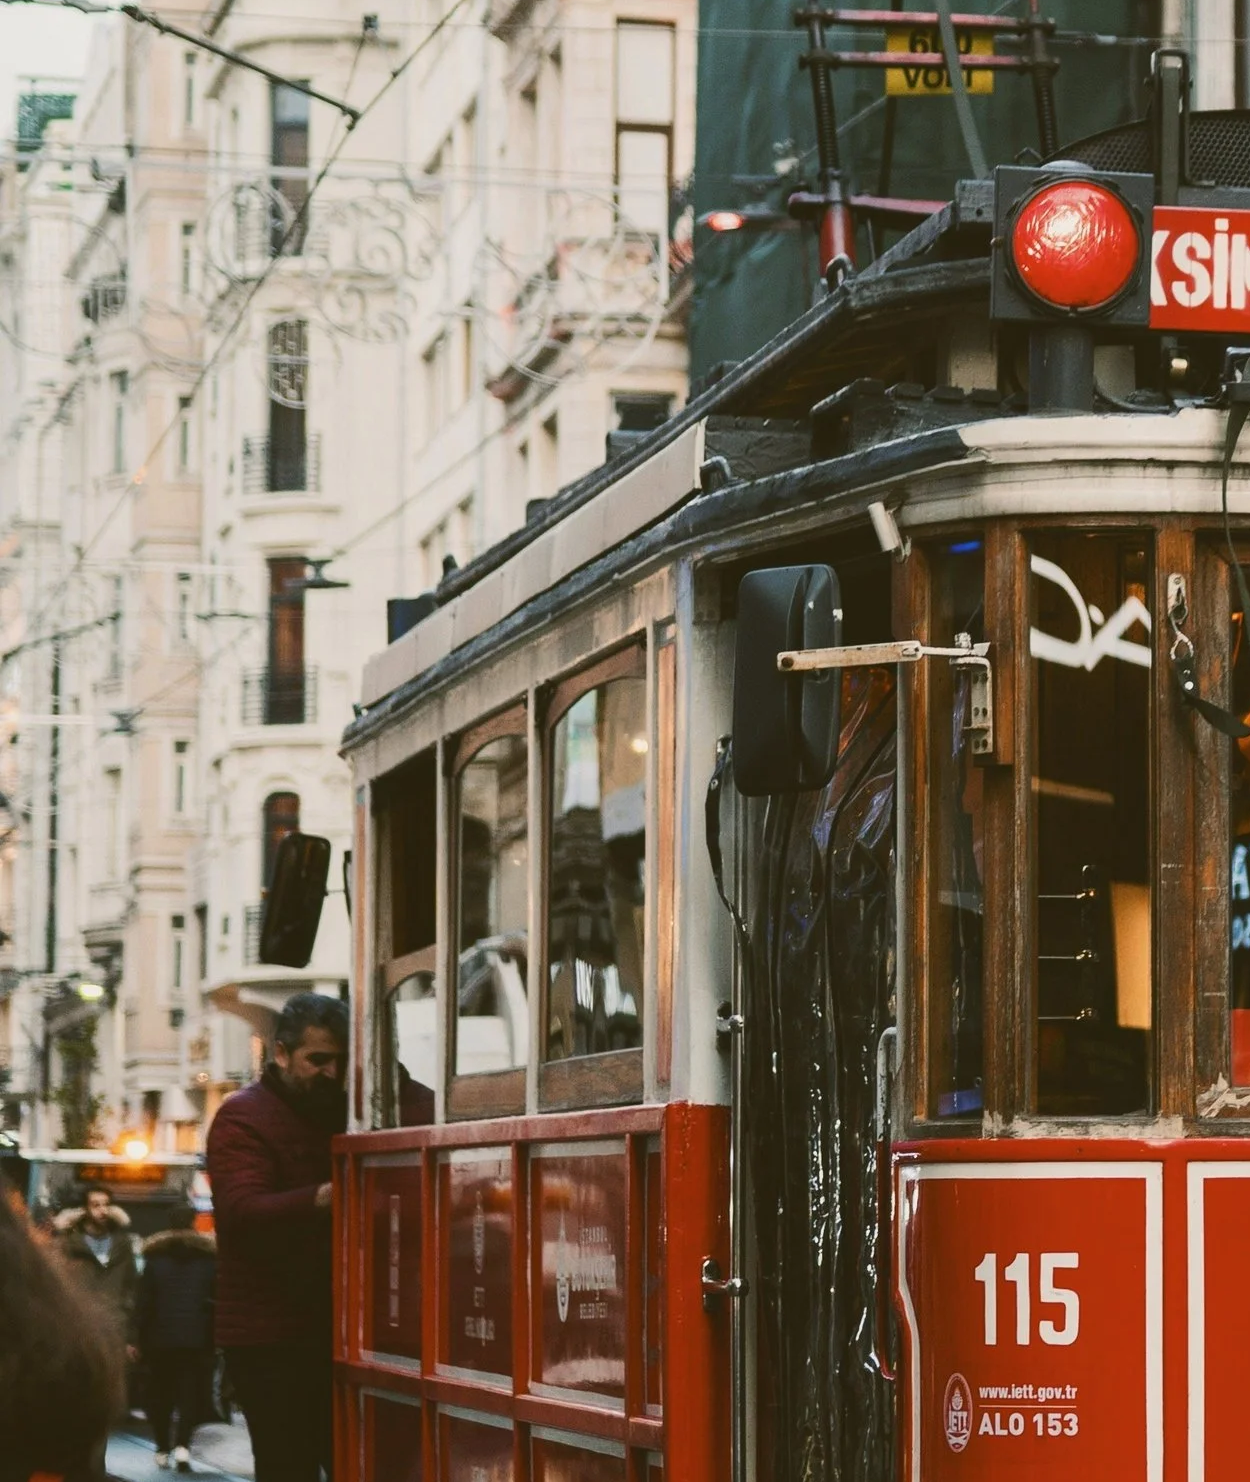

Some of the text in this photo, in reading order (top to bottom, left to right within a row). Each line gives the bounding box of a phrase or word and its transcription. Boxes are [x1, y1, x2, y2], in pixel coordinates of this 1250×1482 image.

[974, 1252, 1080, 1346] 115
[978, 1383, 1078, 1403] www.iett.gov.tr
[978, 1412, 1079, 1437] ALO 153
